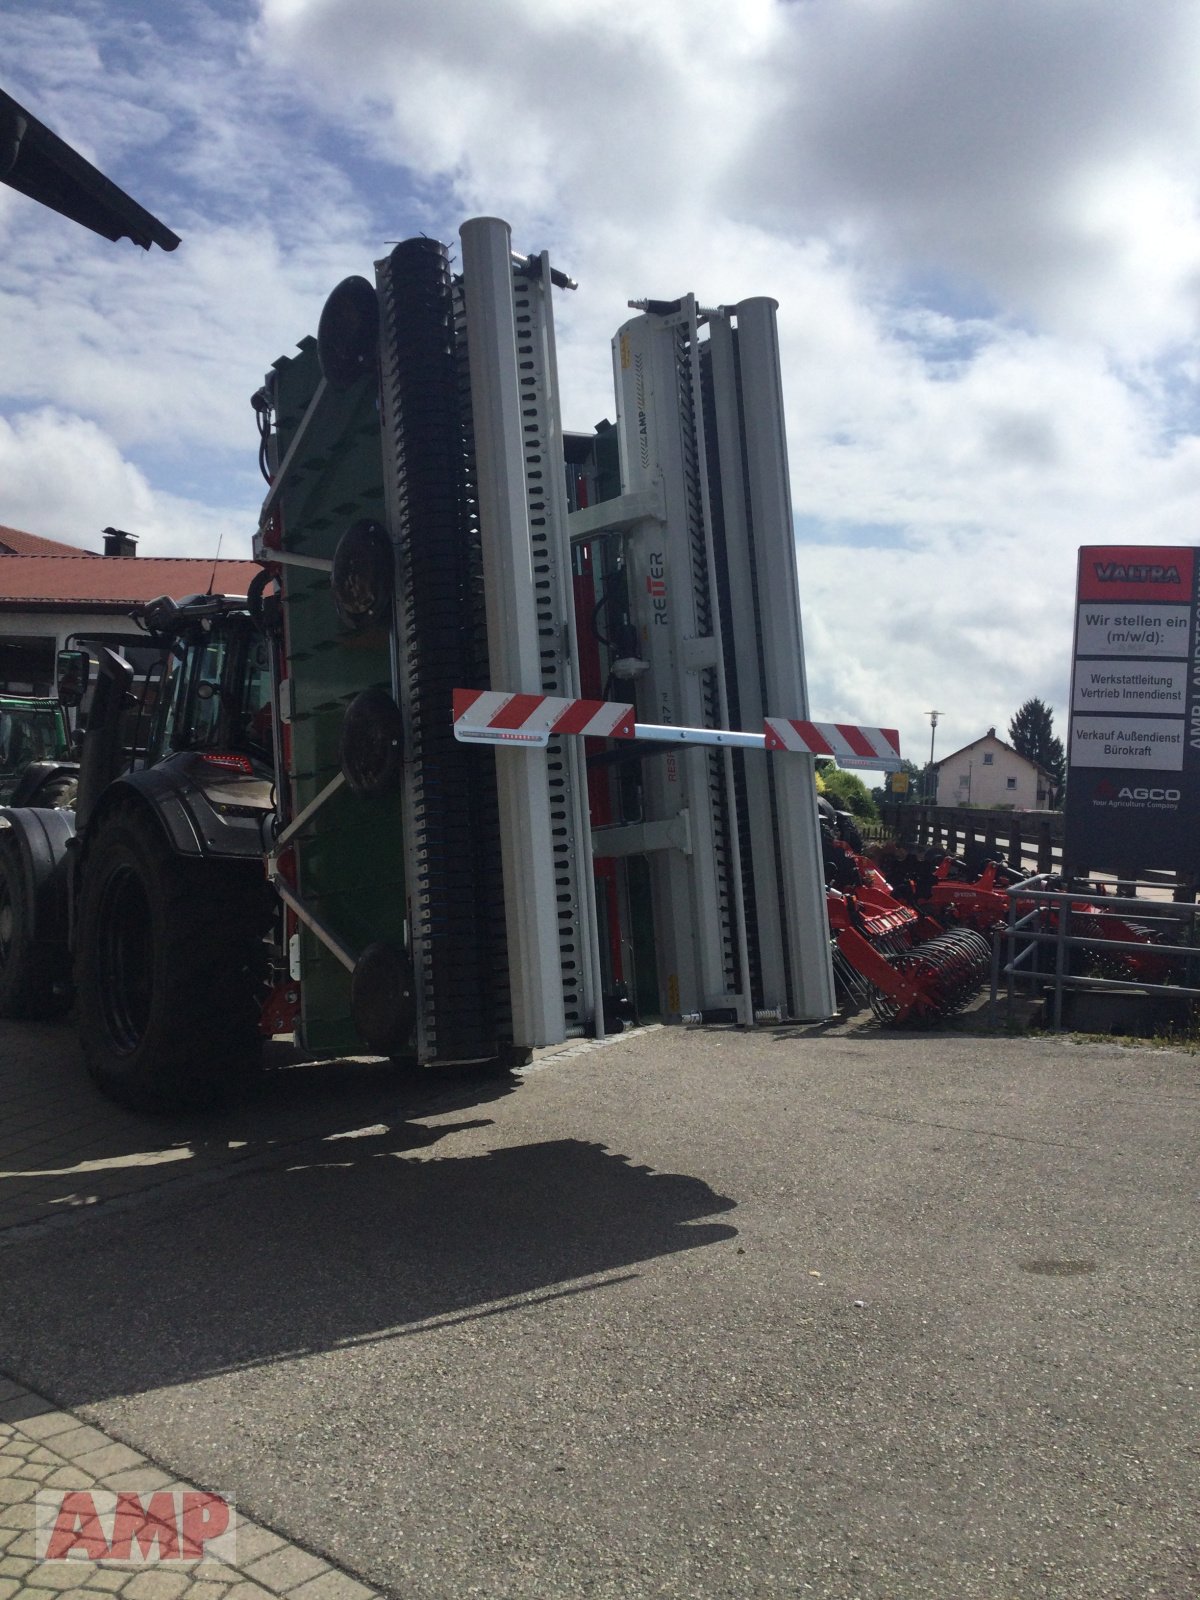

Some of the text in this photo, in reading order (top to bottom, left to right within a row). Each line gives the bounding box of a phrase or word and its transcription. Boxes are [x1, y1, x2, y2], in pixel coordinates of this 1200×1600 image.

[639, 411, 648, 435] AMP
[1093, 562, 1181, 584] VALTRA
[1085, 614, 1187, 628] Wir stellen ein
[1107, 631, 1164, 645] (m/w/d):
[1090, 673, 1173, 688] Werkstattleitung
[1080, 687, 1181, 700] Vertrieb Innendienst
[1076, 729, 1181, 743] Verkauf Außendienst
[1103, 744, 1152, 756] Bürokraft
[1118, 787, 1181, 801] AGCO
[1108, 800, 1145, 808] Agriculture
[1147, 801, 1178, 811] Company
